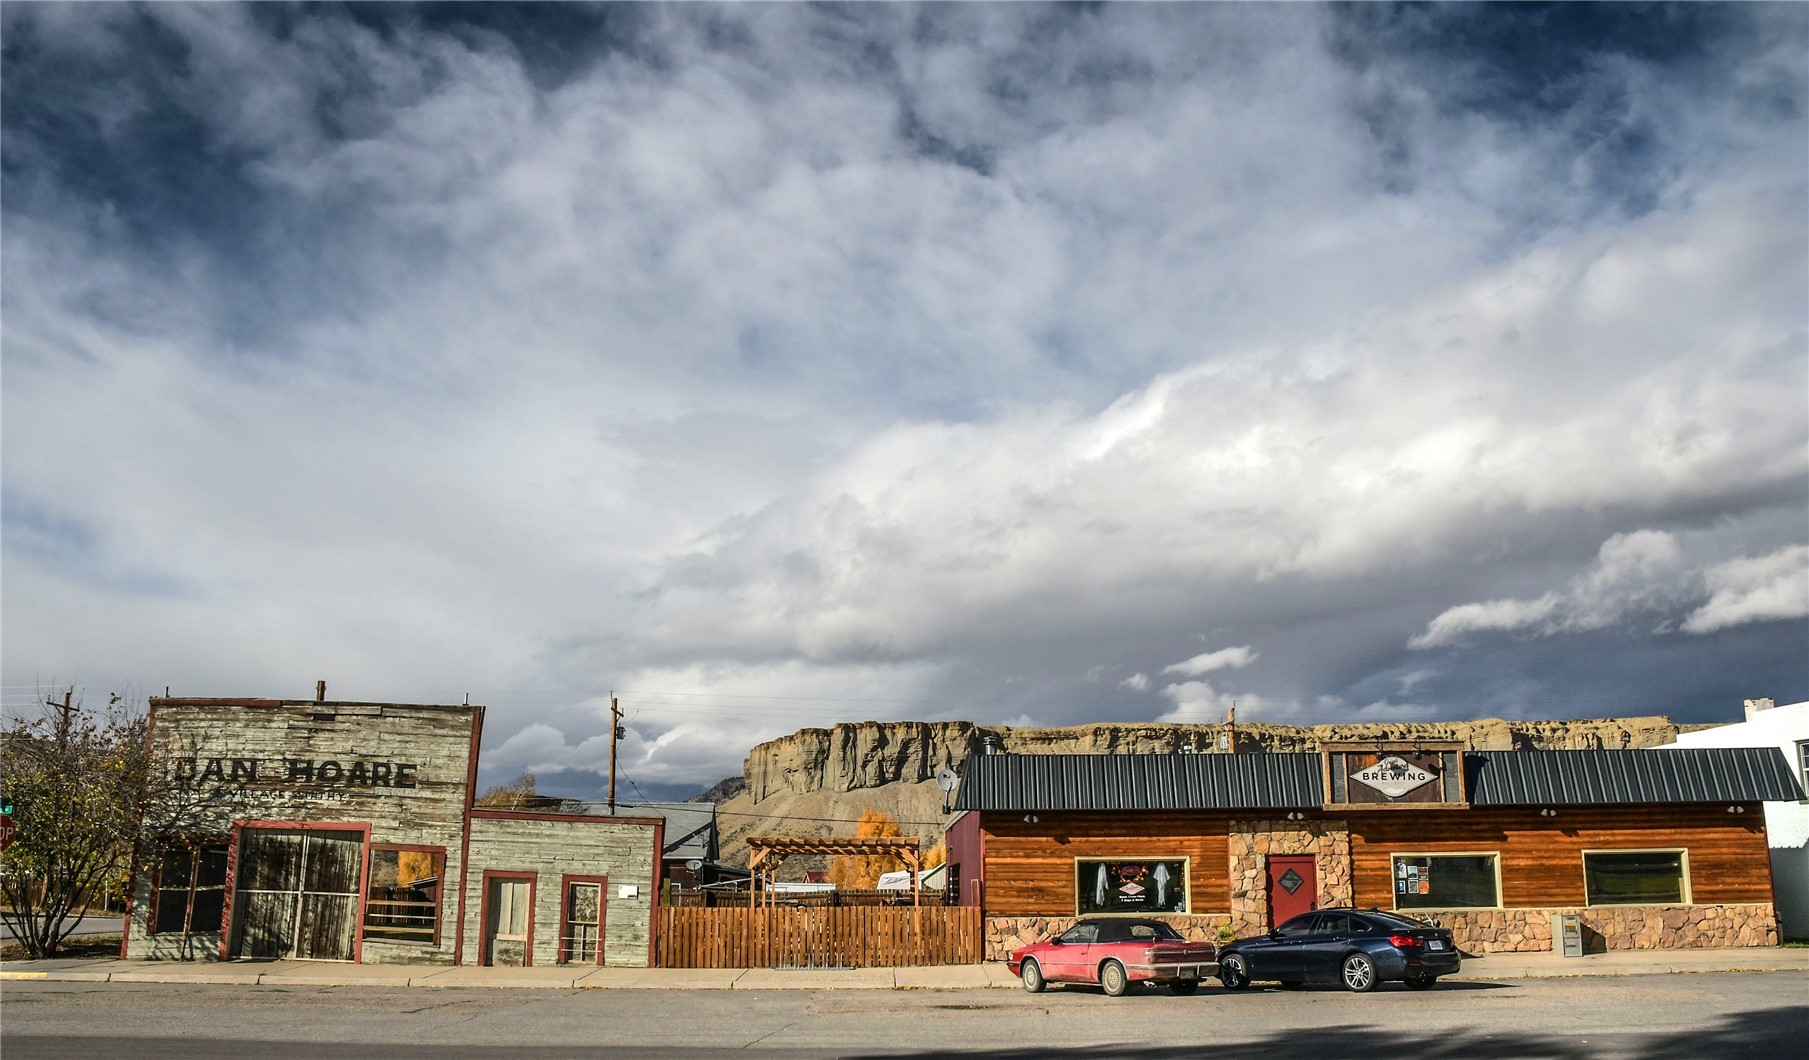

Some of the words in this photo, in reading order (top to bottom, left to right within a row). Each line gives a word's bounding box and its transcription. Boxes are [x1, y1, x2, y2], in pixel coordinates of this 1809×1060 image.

[174, 758, 258, 783] DAN
[287, 759, 418, 789] HOARE
[1362, 772, 1426, 780] BREWING
